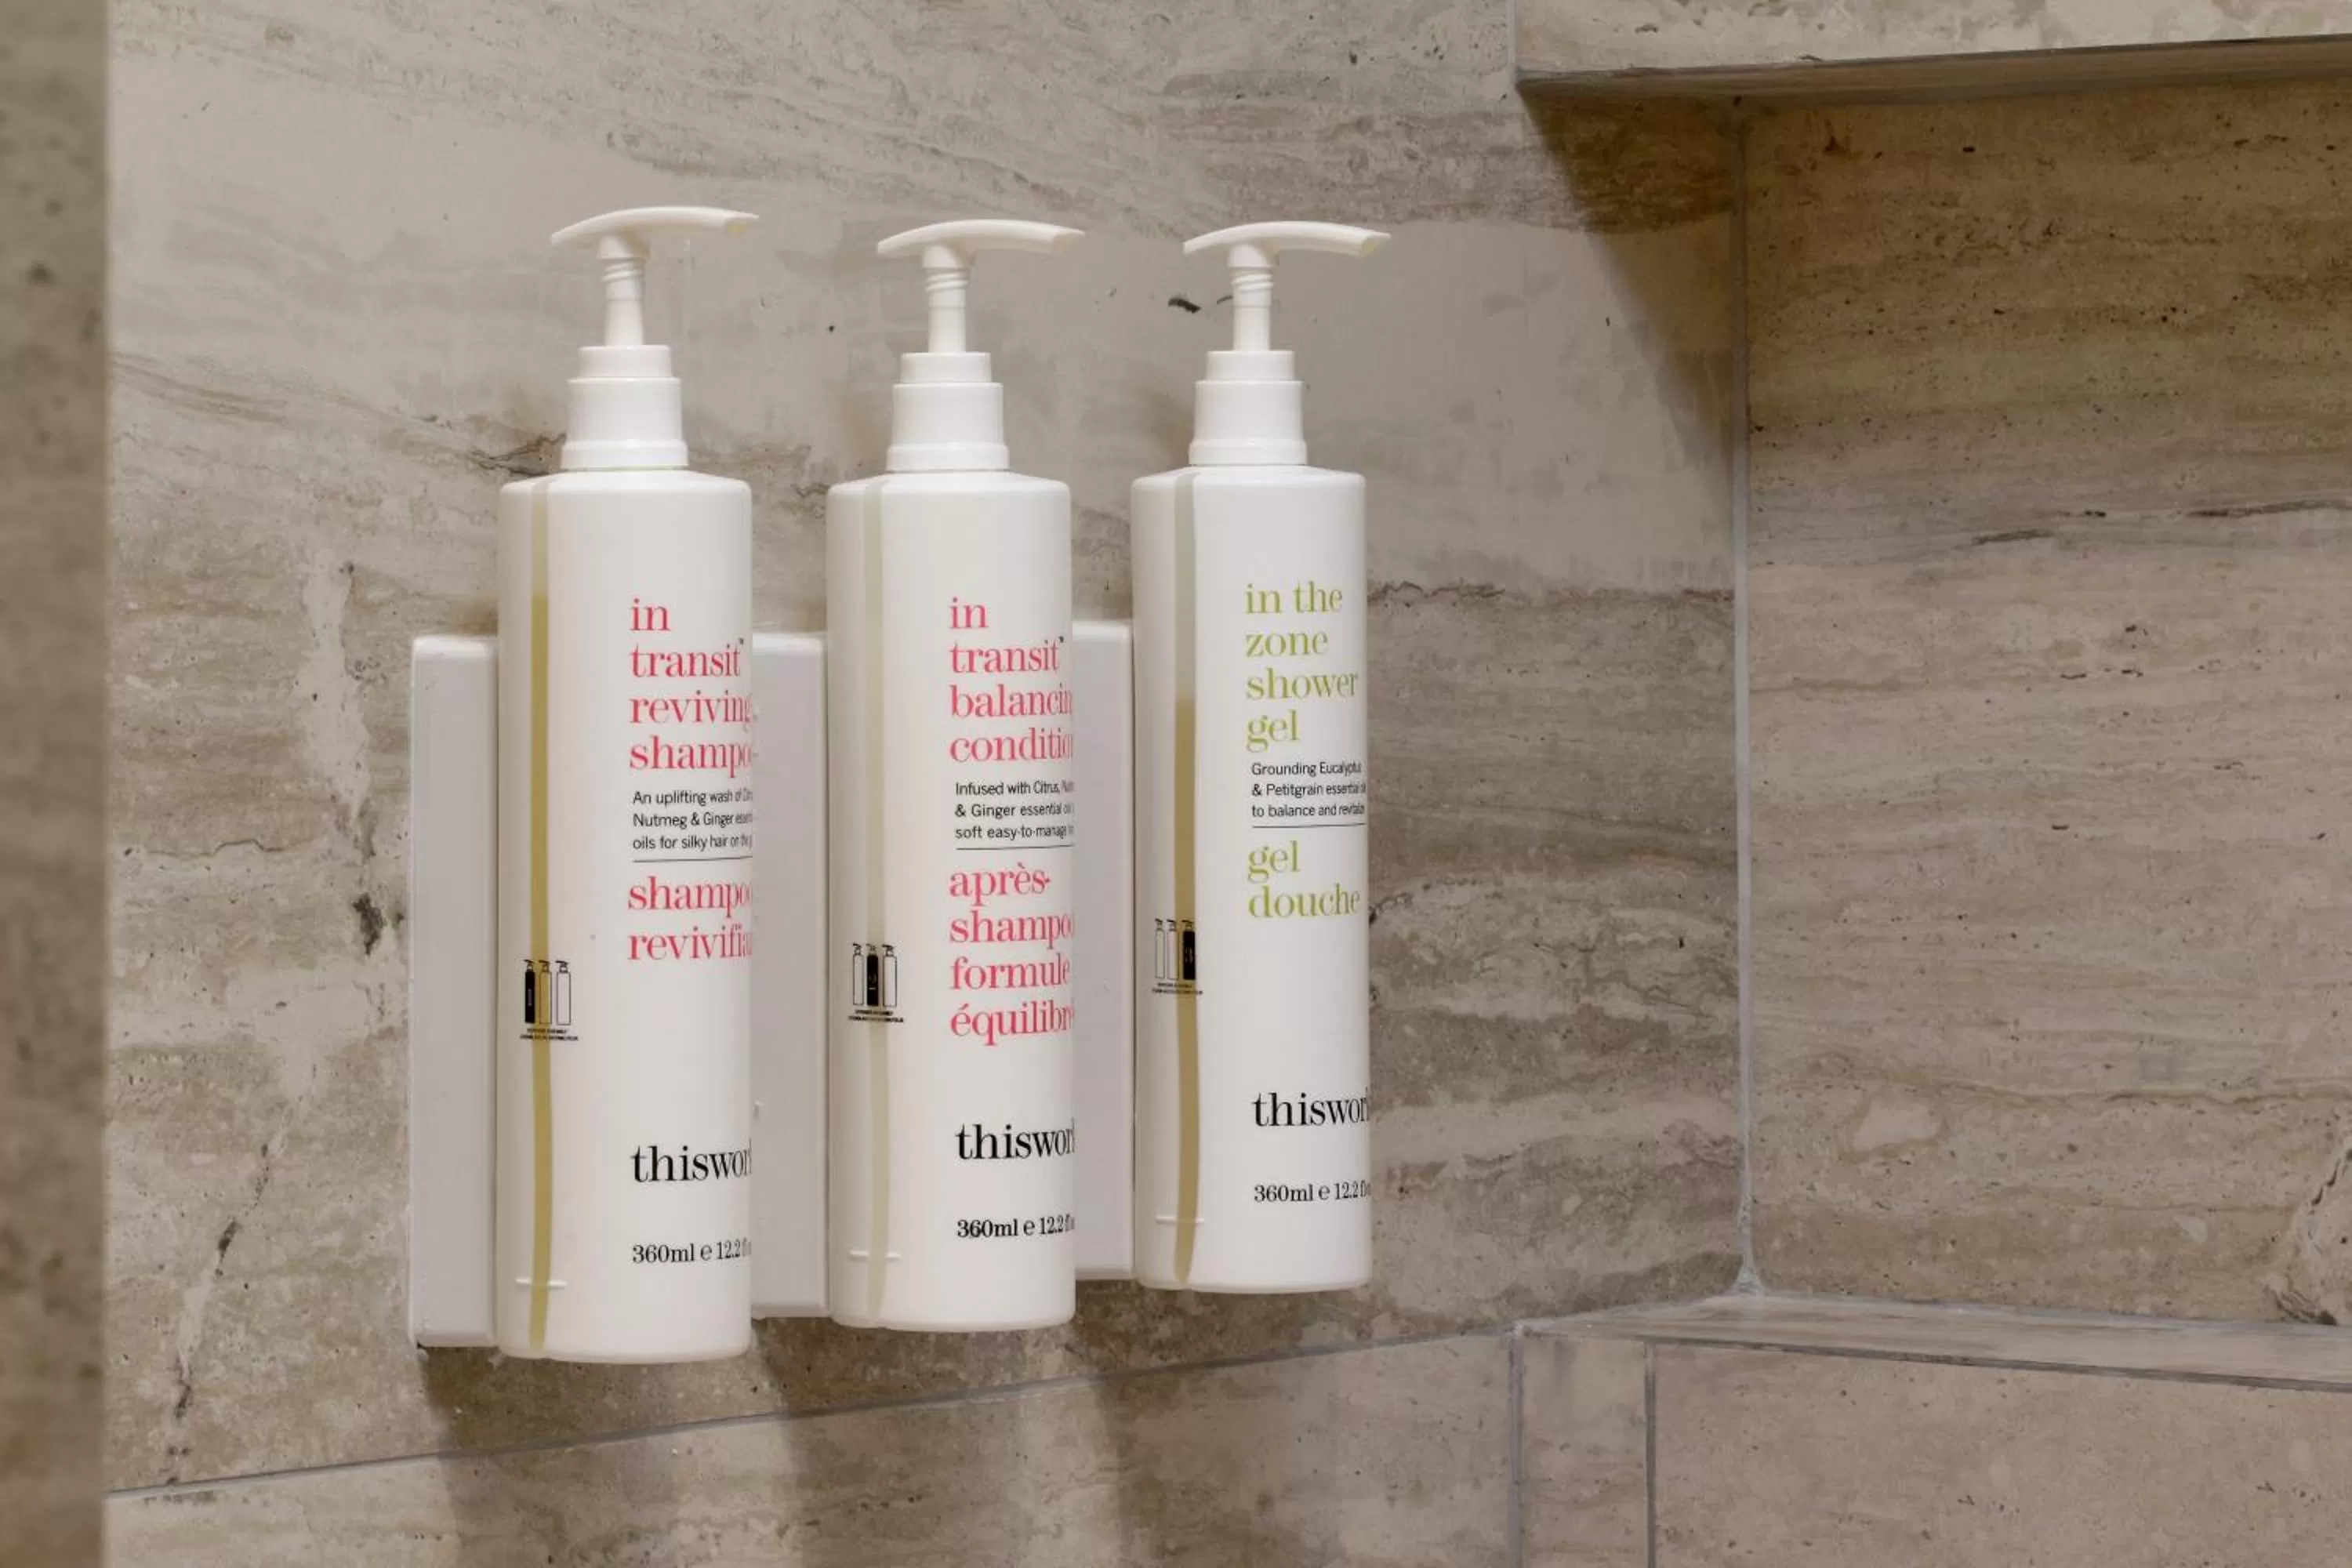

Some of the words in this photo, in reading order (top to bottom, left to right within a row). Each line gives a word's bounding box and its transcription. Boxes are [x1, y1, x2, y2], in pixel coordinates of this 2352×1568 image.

[1245, 583, 1283, 614] in
[1294, 579, 1343, 614] the
[630, 597, 671, 632] in
[949, 597, 988, 629] in
[949, 640, 1059, 673] transit
[1245, 630, 1329, 658] zone
[630, 642, 742, 677] transit
[1246, 667, 1359, 700] shower
[949, 683, 1073, 717] balancin
[949, 727, 1073, 763] conditio
[1245, 709, 1301, 753] gel
[630, 734, 752, 779] shampo
[1251, 762, 1316, 777] Grounding
[633, 791, 652, 804] An
[656, 790, 706, 807] uplifting
[710, 788, 733, 802] wash
[956, 782, 1004, 796] Infused
[1007, 782, 1031, 794] with
[1252, 783, 1262, 797] &
[1266, 783, 1323, 799] Petitgrain
[633, 812, 688, 829] Nutmeg
[691, 812, 700, 826] &
[703, 811, 734, 828] Ginger
[954, 804, 966, 818] &
[971, 804, 1015, 819] Ginger
[1252, 804, 1265, 817] to
[1268, 804, 1316, 816] balance
[1319, 803, 1336, 816] and
[633, 836, 656, 849] oils
[659, 834, 678, 848] for
[681, 834, 706, 851] silky
[955, 826, 982, 839] soft
[1247, 840, 1301, 884] gel
[1248, 883, 1361, 919] douche
[950, 953, 1070, 990] formule
[1254, 1184, 1314, 1202] 360ml
[1318, 1185, 1330, 1200] e
[956, 1218, 1019, 1238] 360ml
[1023, 1220, 1036, 1236] e
[633, 1243, 695, 1264] 360ml
[700, 1245, 713, 1261] e
